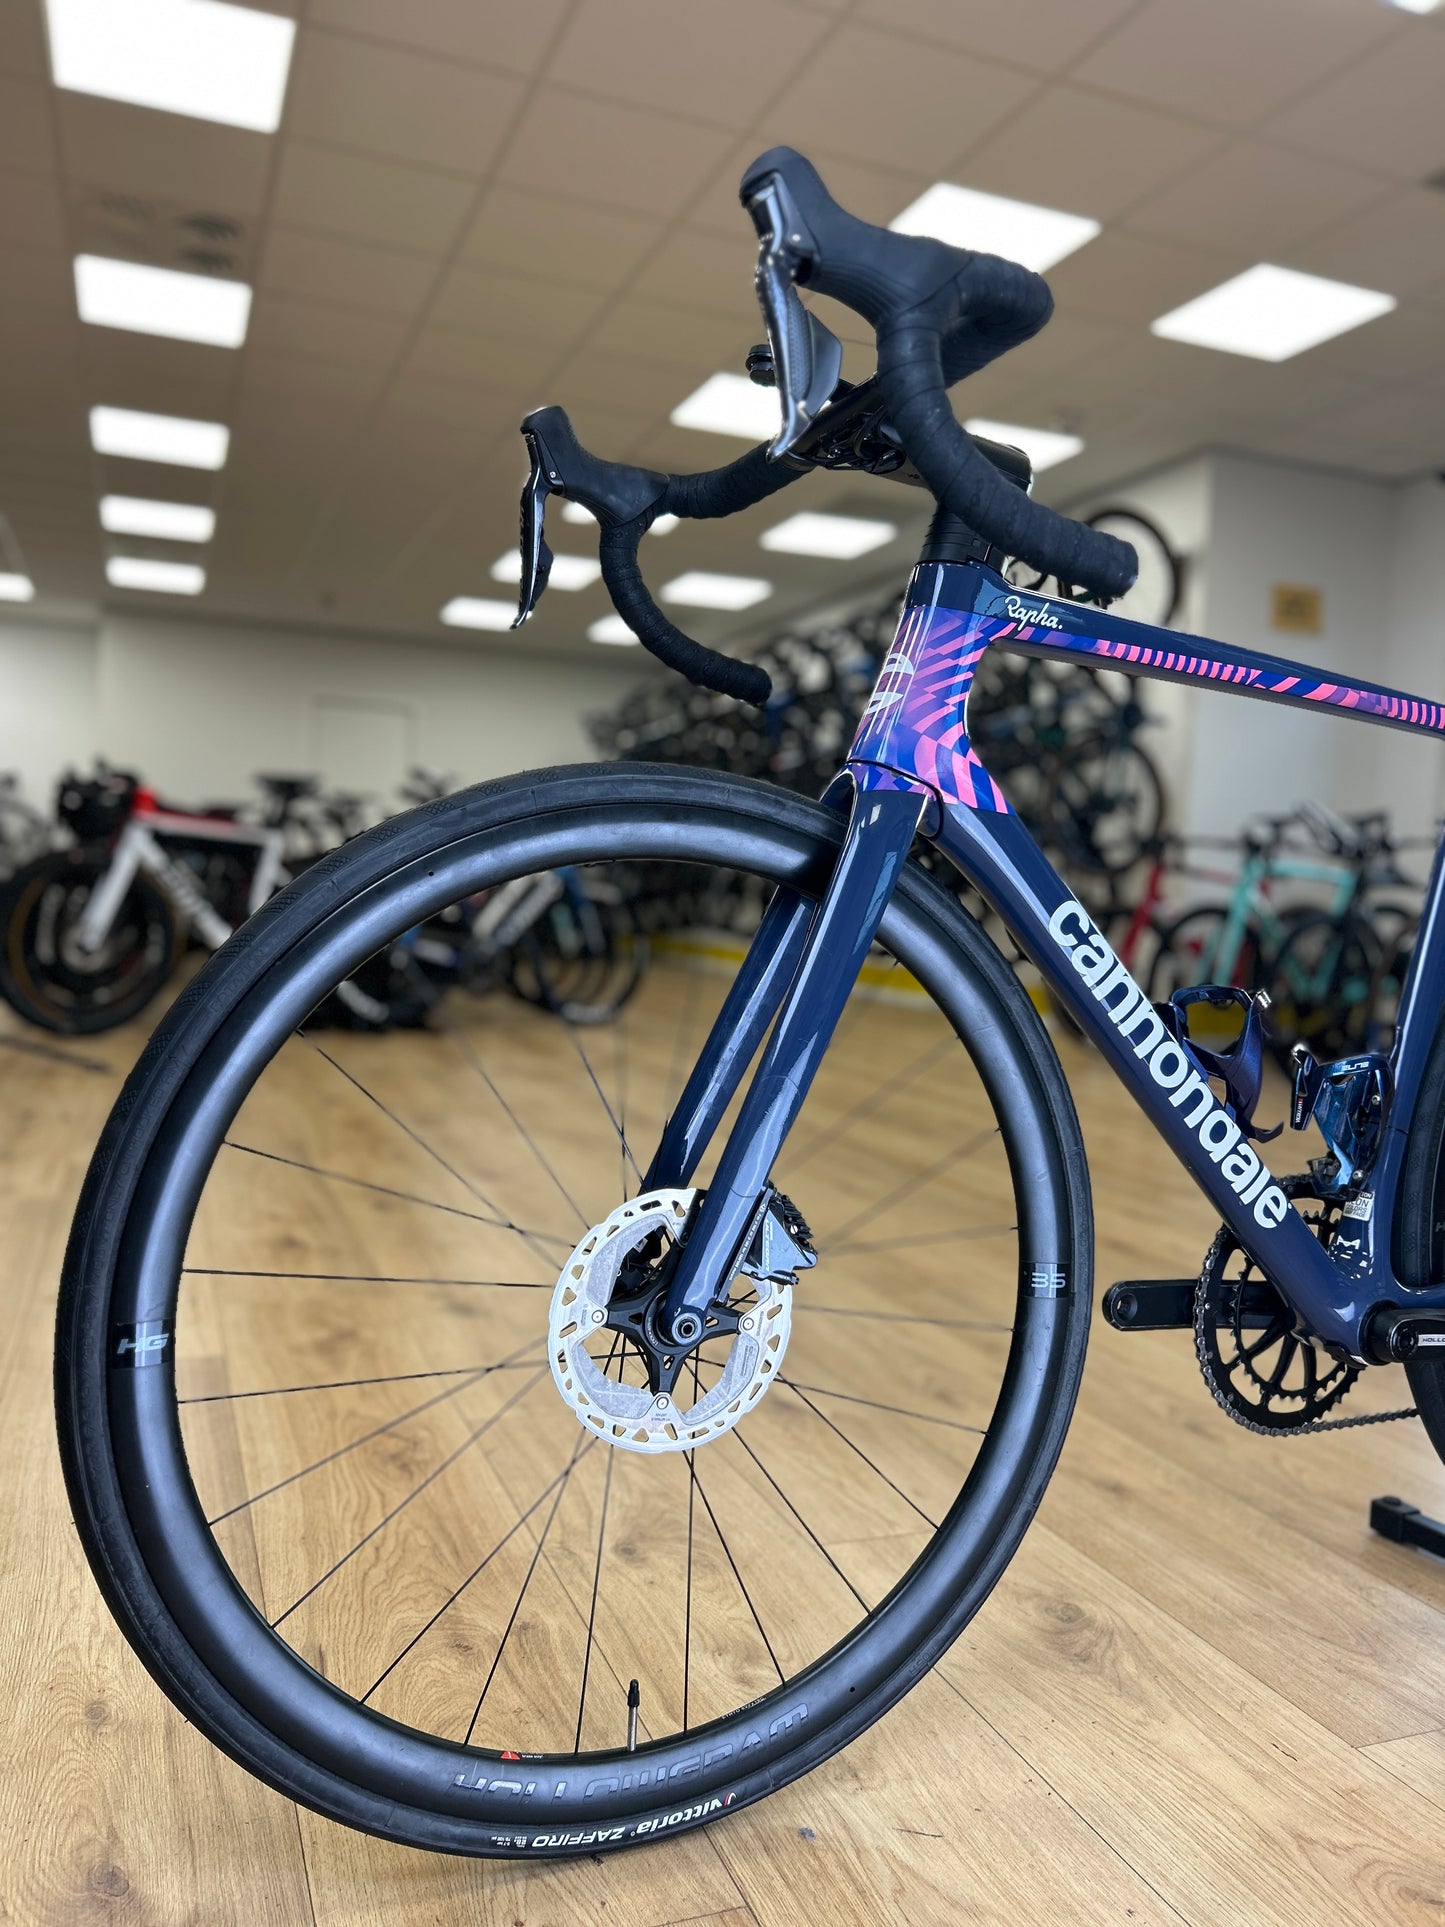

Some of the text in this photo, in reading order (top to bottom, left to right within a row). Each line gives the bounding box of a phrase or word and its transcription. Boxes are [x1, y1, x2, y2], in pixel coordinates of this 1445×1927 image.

[1049, 900, 1288, 1229] cannondale
[1031, 1272, 1066, 1289] 35
[531, 1826, 627, 1848] ZAFFIRO
